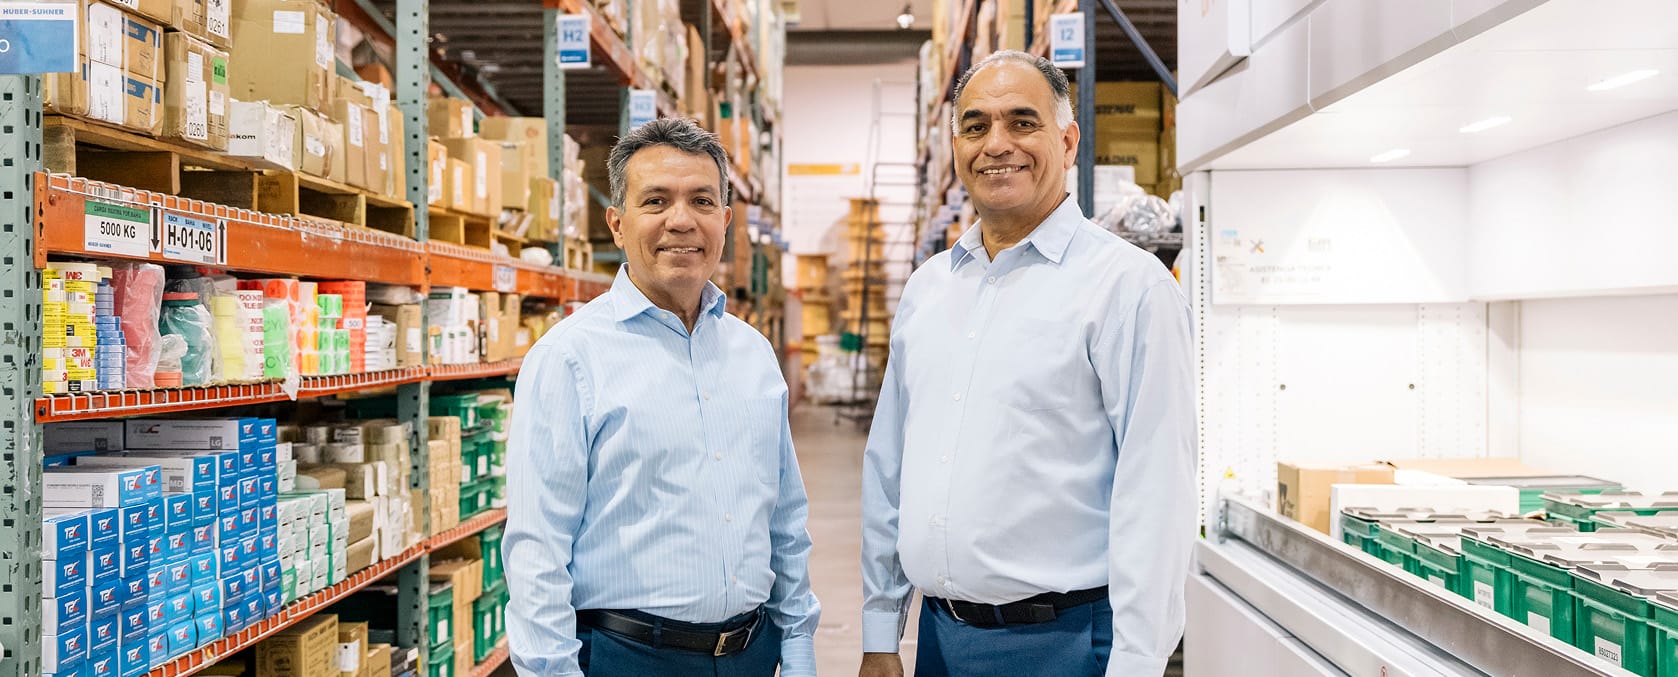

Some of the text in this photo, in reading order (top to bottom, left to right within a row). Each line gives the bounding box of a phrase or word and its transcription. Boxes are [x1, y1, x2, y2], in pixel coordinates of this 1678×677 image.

[563, 29, 583, 42] H2
[100, 221, 136, 239] 5000 KG
[71, 348, 87, 358] 3M
[211, 438, 222, 447] LG
[170, 479, 184, 489] MD
